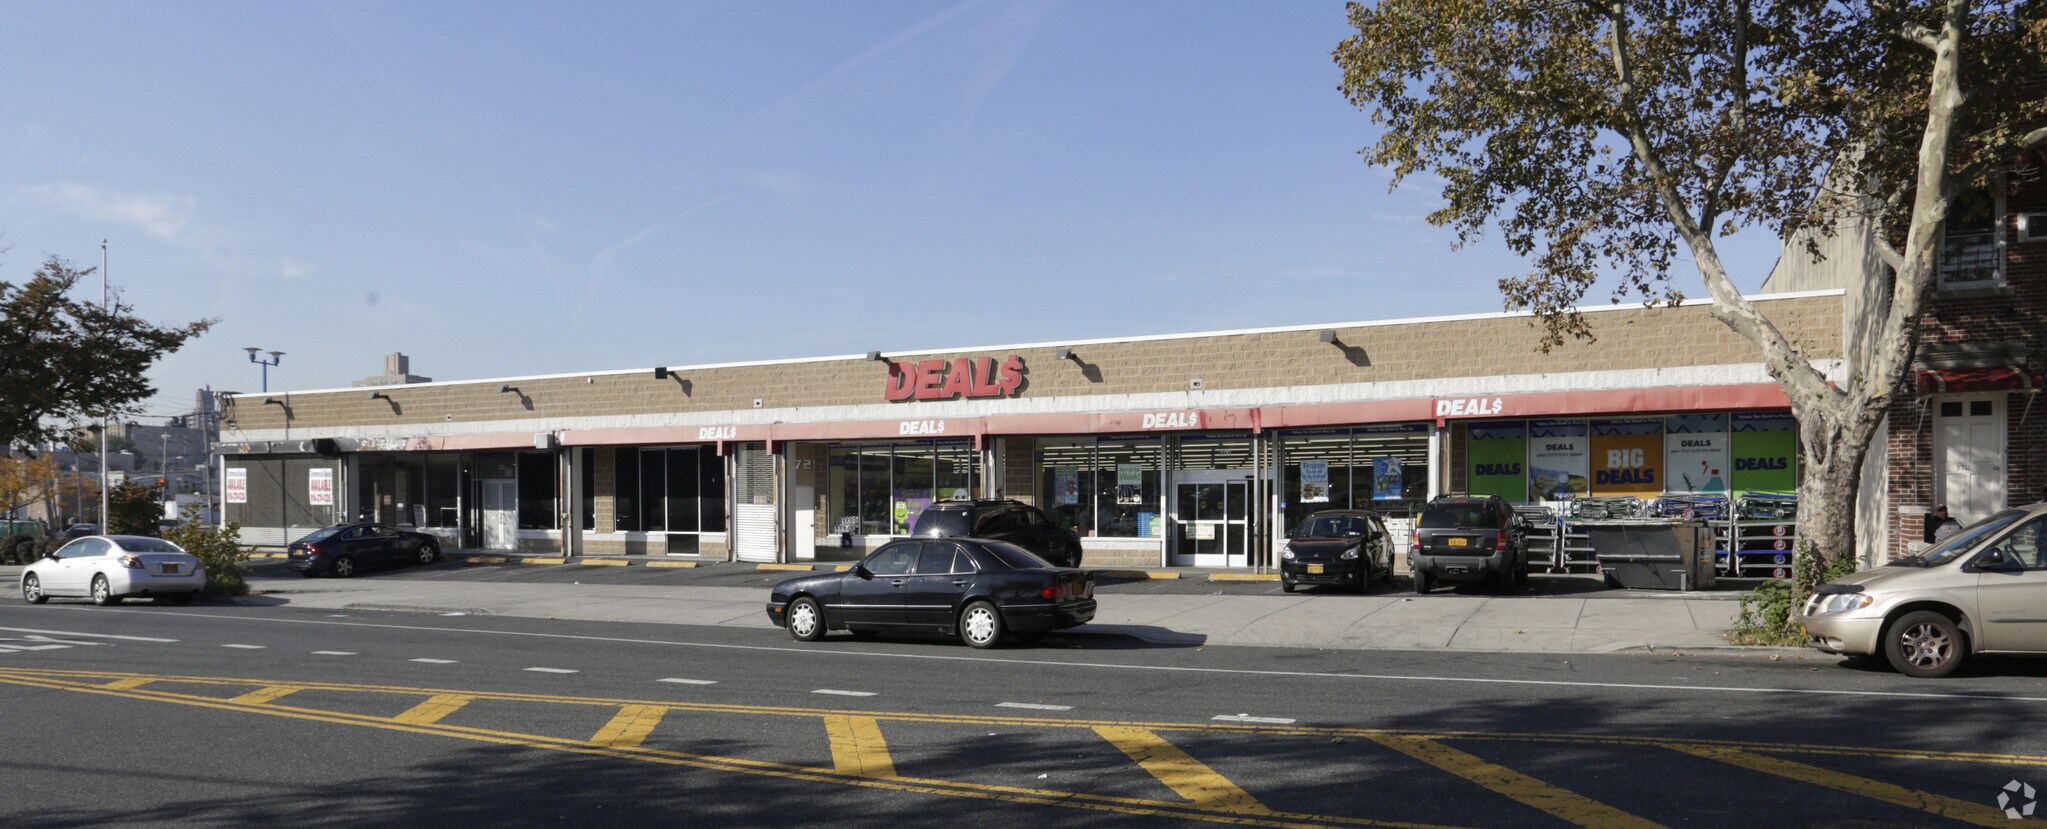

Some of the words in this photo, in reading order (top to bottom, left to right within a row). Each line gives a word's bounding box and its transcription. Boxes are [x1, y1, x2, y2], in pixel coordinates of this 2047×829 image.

[885, 355, 1022, 401] DEAL$
[1436, 398, 1503, 417] DEAL$
[899, 420, 945, 435] DEAL$
[1142, 412, 1198, 429] DEAL$
[698, 426, 737, 440] DEAL$
[1606, 448, 1645, 469] BIG
[1735, 457, 1788, 471] DEALS
[1475, 463, 1521, 476] DEALS
[1596, 468, 1656, 485] DEALS
